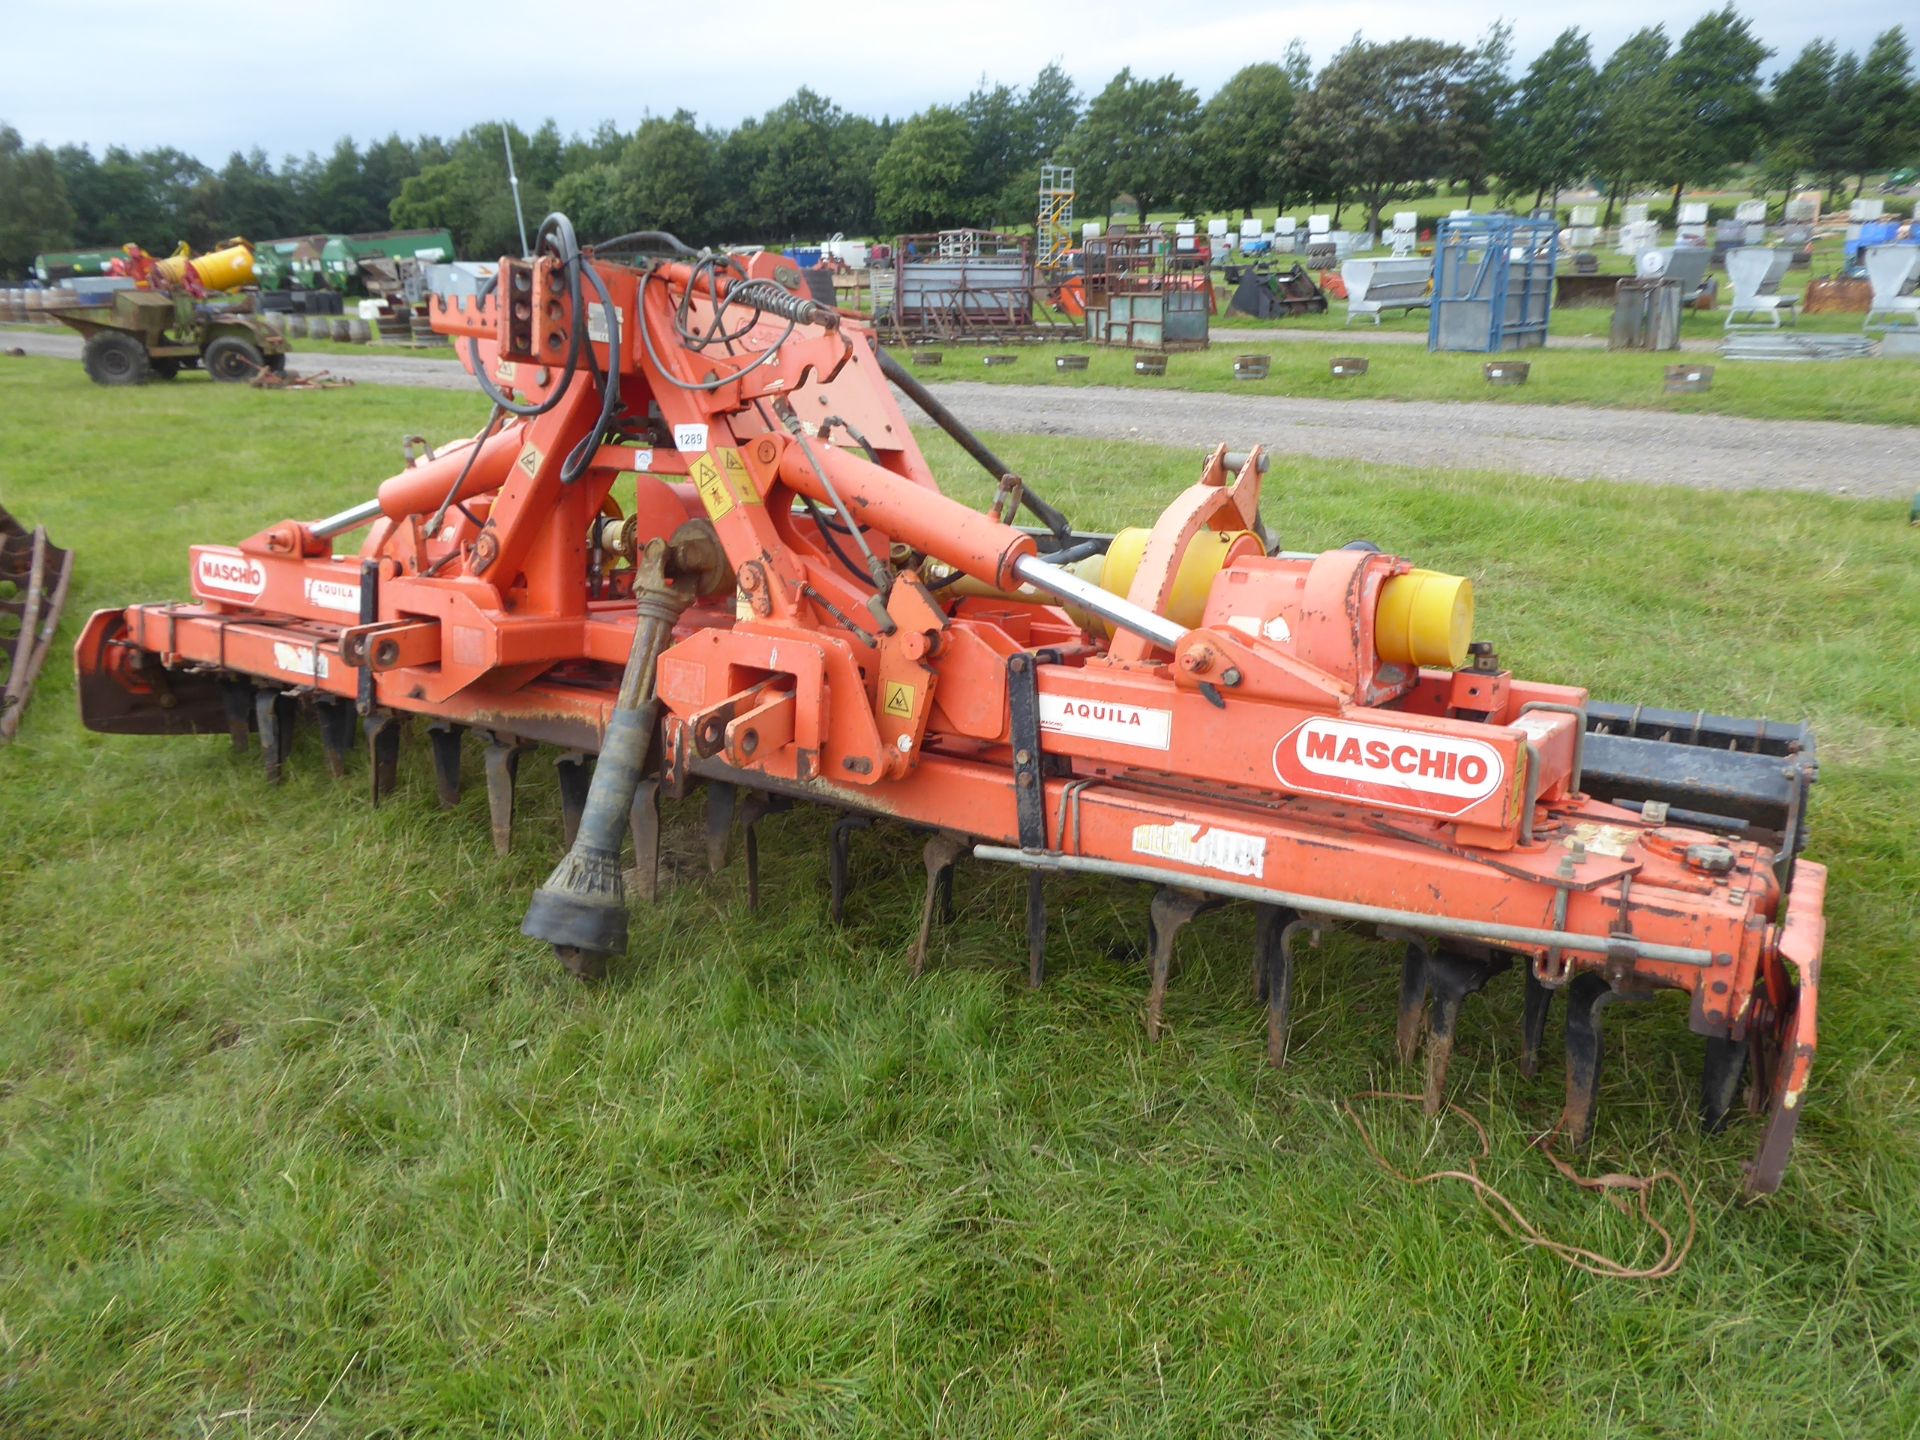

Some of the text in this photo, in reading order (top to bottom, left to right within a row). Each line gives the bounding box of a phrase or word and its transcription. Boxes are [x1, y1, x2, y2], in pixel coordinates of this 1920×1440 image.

[679, 433, 703, 445] 1289
[203, 561, 260, 586] MASCHIO
[317, 584, 353, 599] AQUILA
[1063, 702, 1141, 727] AQUILA
[1305, 730, 1488, 785] MASCHIO
